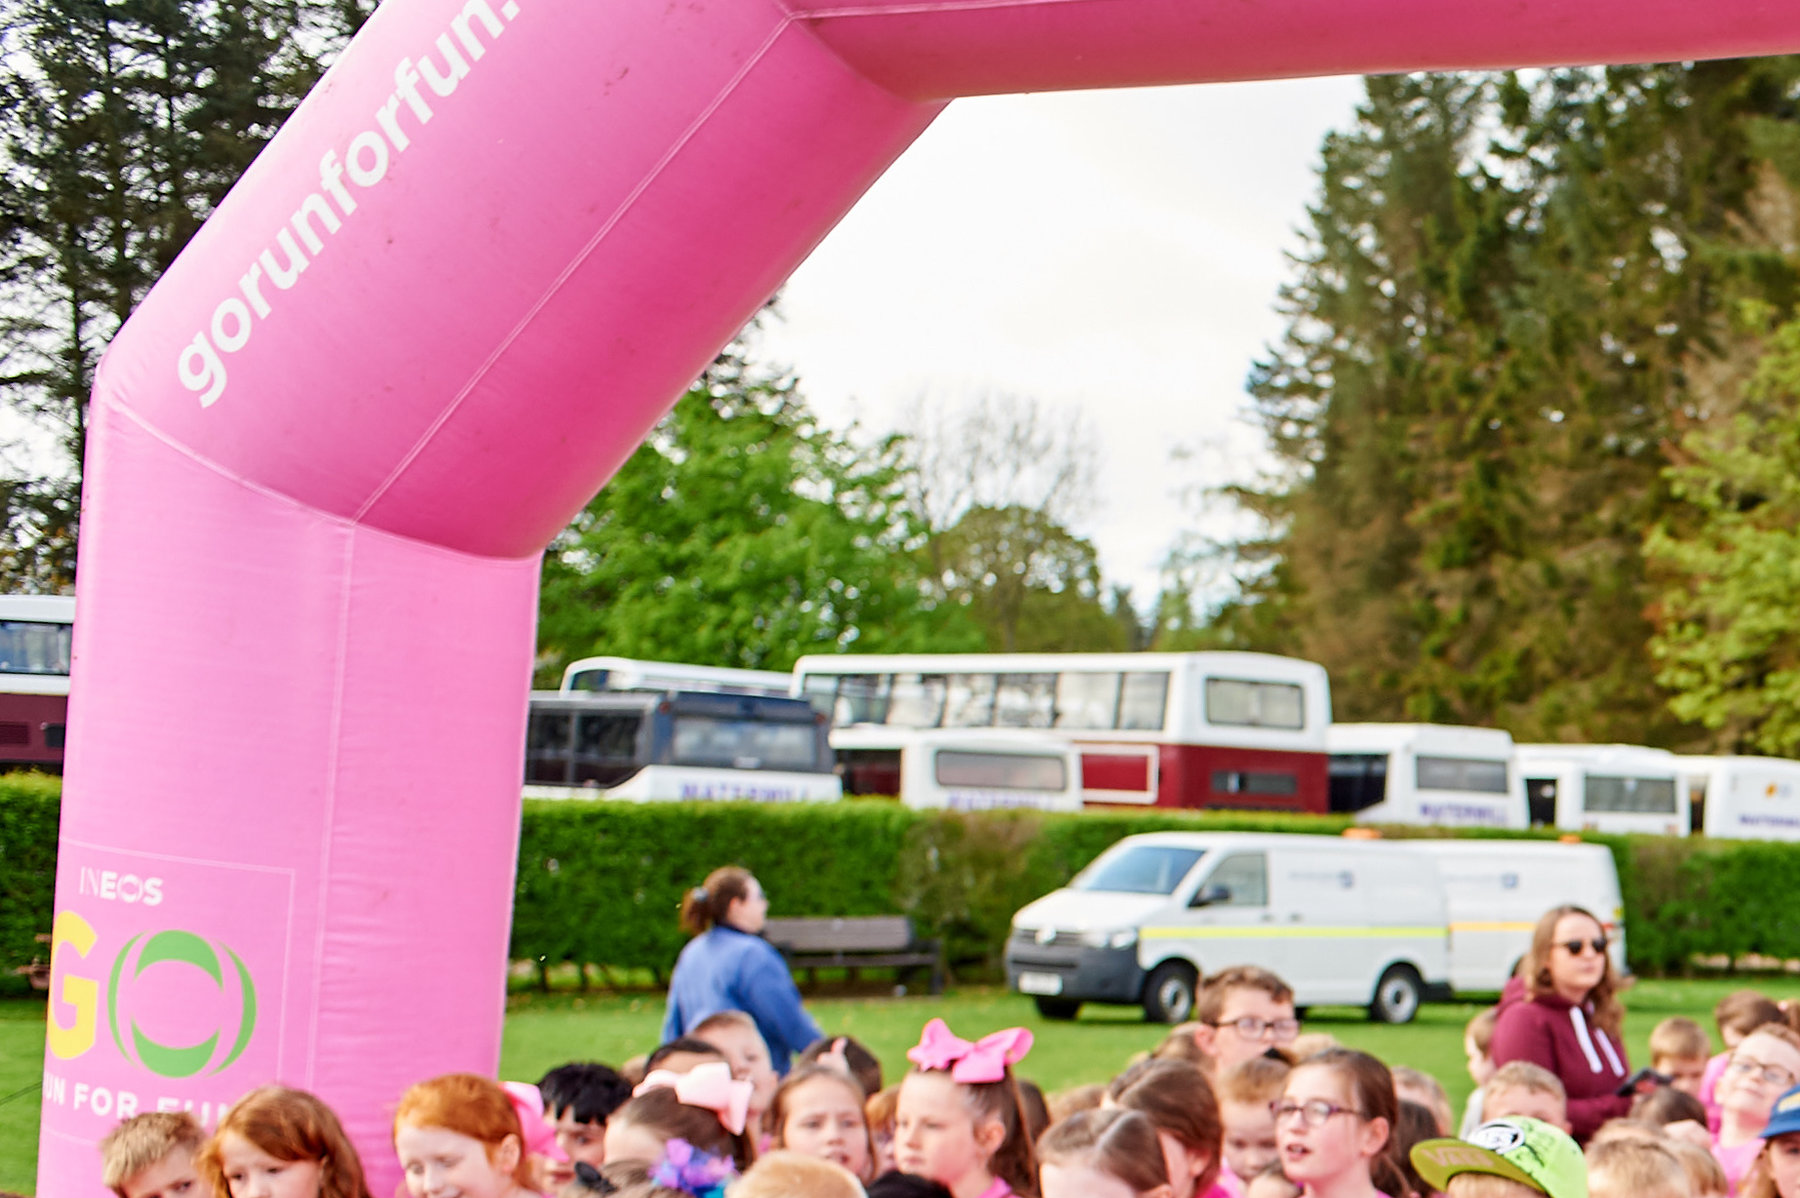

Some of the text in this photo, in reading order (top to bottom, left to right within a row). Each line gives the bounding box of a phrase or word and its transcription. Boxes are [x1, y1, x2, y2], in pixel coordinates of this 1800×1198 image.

[79, 866, 164, 906] INEOS
[47, 910, 257, 1079] GO
[73, 1082, 138, 1120] FOR
